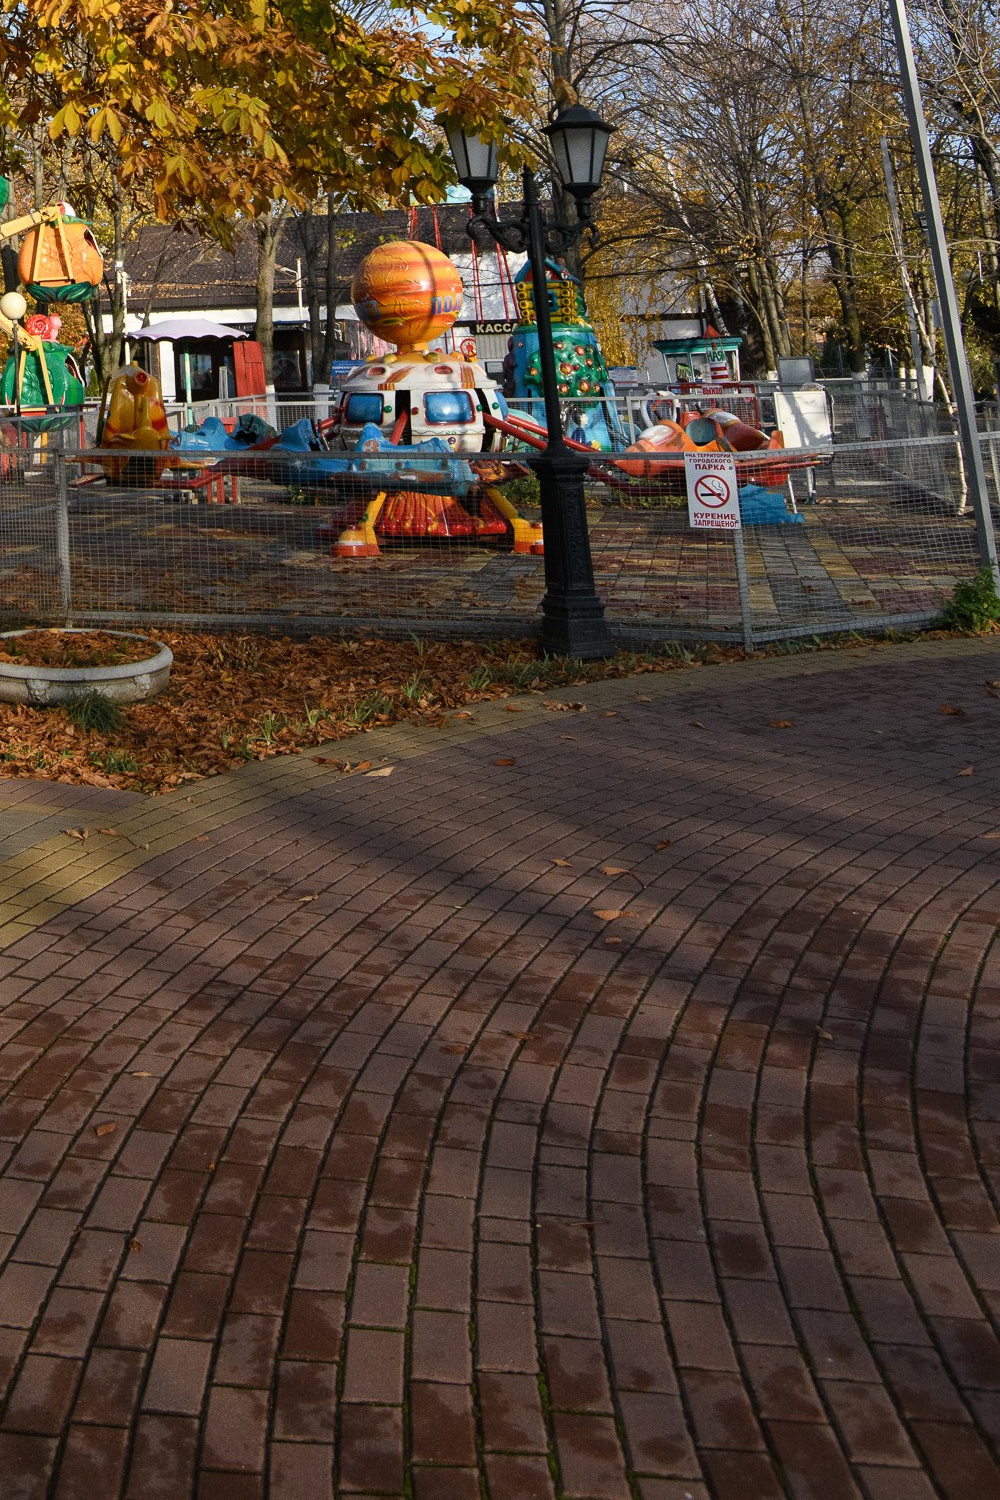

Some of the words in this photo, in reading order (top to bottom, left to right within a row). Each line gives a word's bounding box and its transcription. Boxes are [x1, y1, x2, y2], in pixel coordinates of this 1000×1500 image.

[694, 463, 726, 471] ПАРКА
[693, 512, 736, 520] КУРЕНИЕ
[694, 519, 738, 528] ЗАПРЕЩЕНО!
